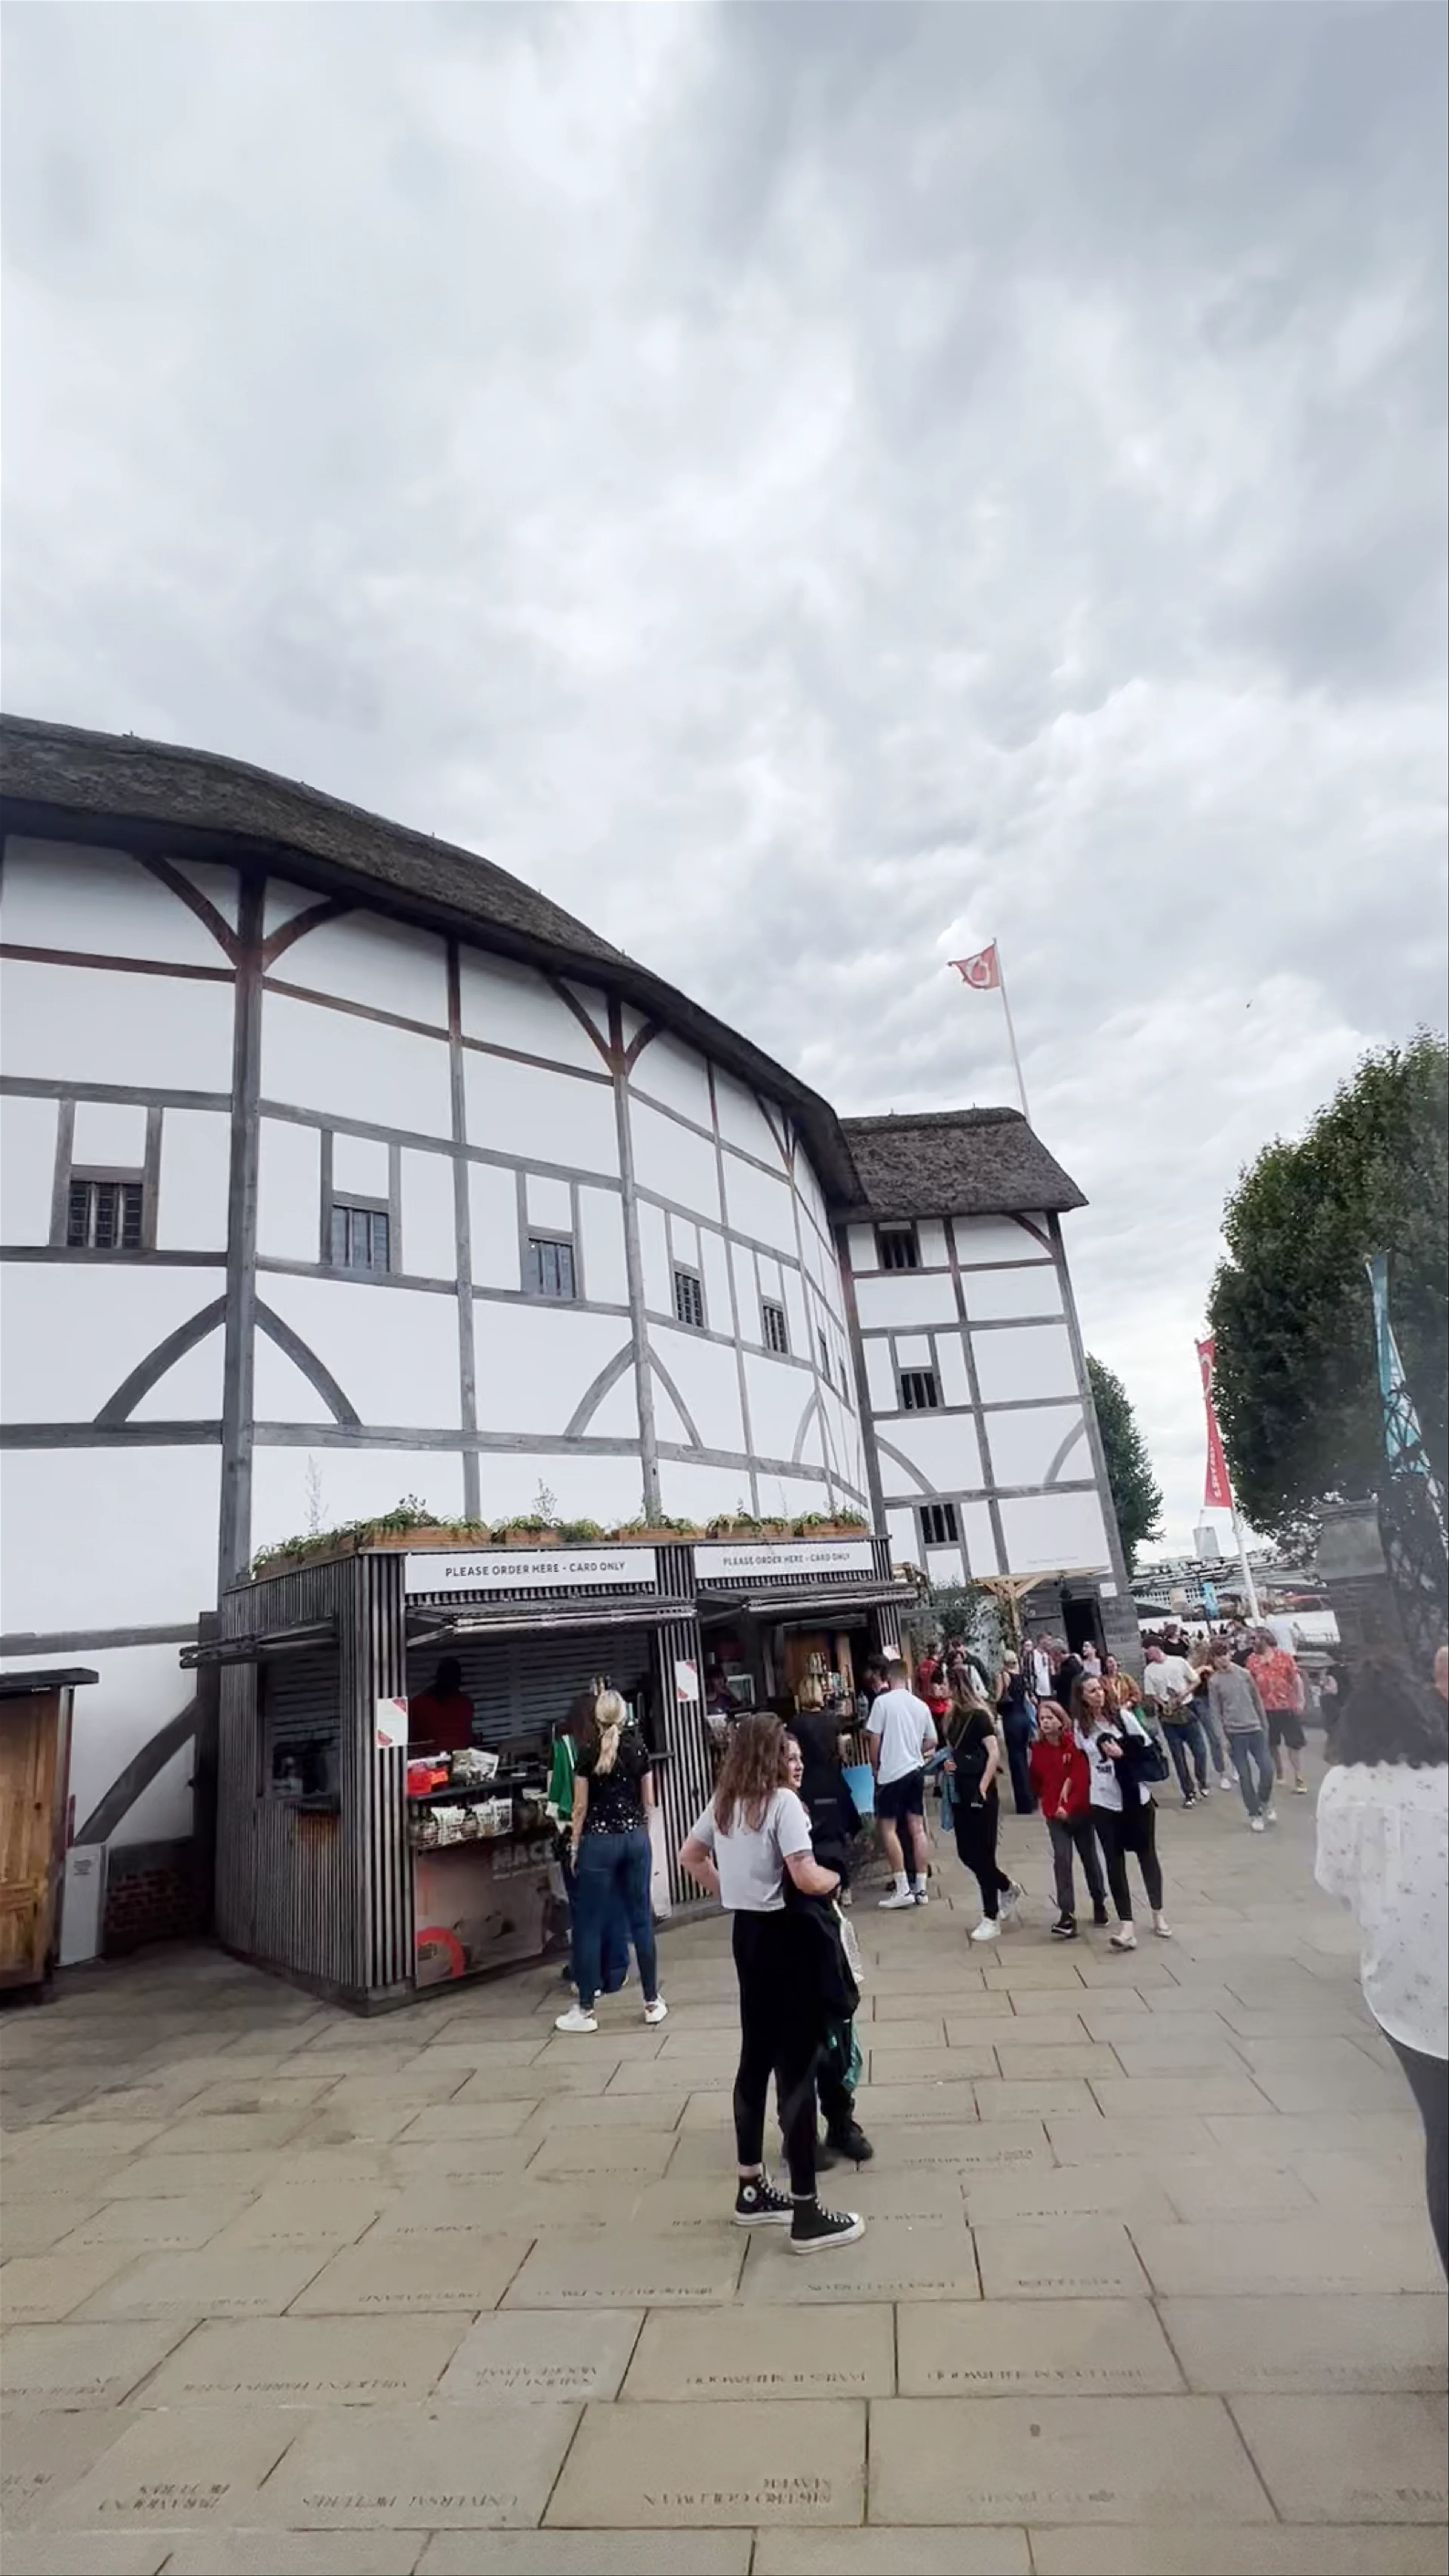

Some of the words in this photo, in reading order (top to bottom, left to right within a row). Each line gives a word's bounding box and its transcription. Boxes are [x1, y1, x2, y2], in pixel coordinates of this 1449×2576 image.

[723, 1556, 754, 1566] PLEASE
[755, 1555, 782, 1565] ORDER
[784, 1554, 804, 1563] HERE
[811, 1553, 830, 1562] CARD
[832, 1552, 850, 1561] ONLY
[445, 1566, 489, 1577] PLEASE
[492, 1565, 529, 1575] ORDER
[532, 1564, 559, 1574] HERE
[569, 1562, 597, 1572] CARD
[600, 1561, 625, 1571] ONLY
